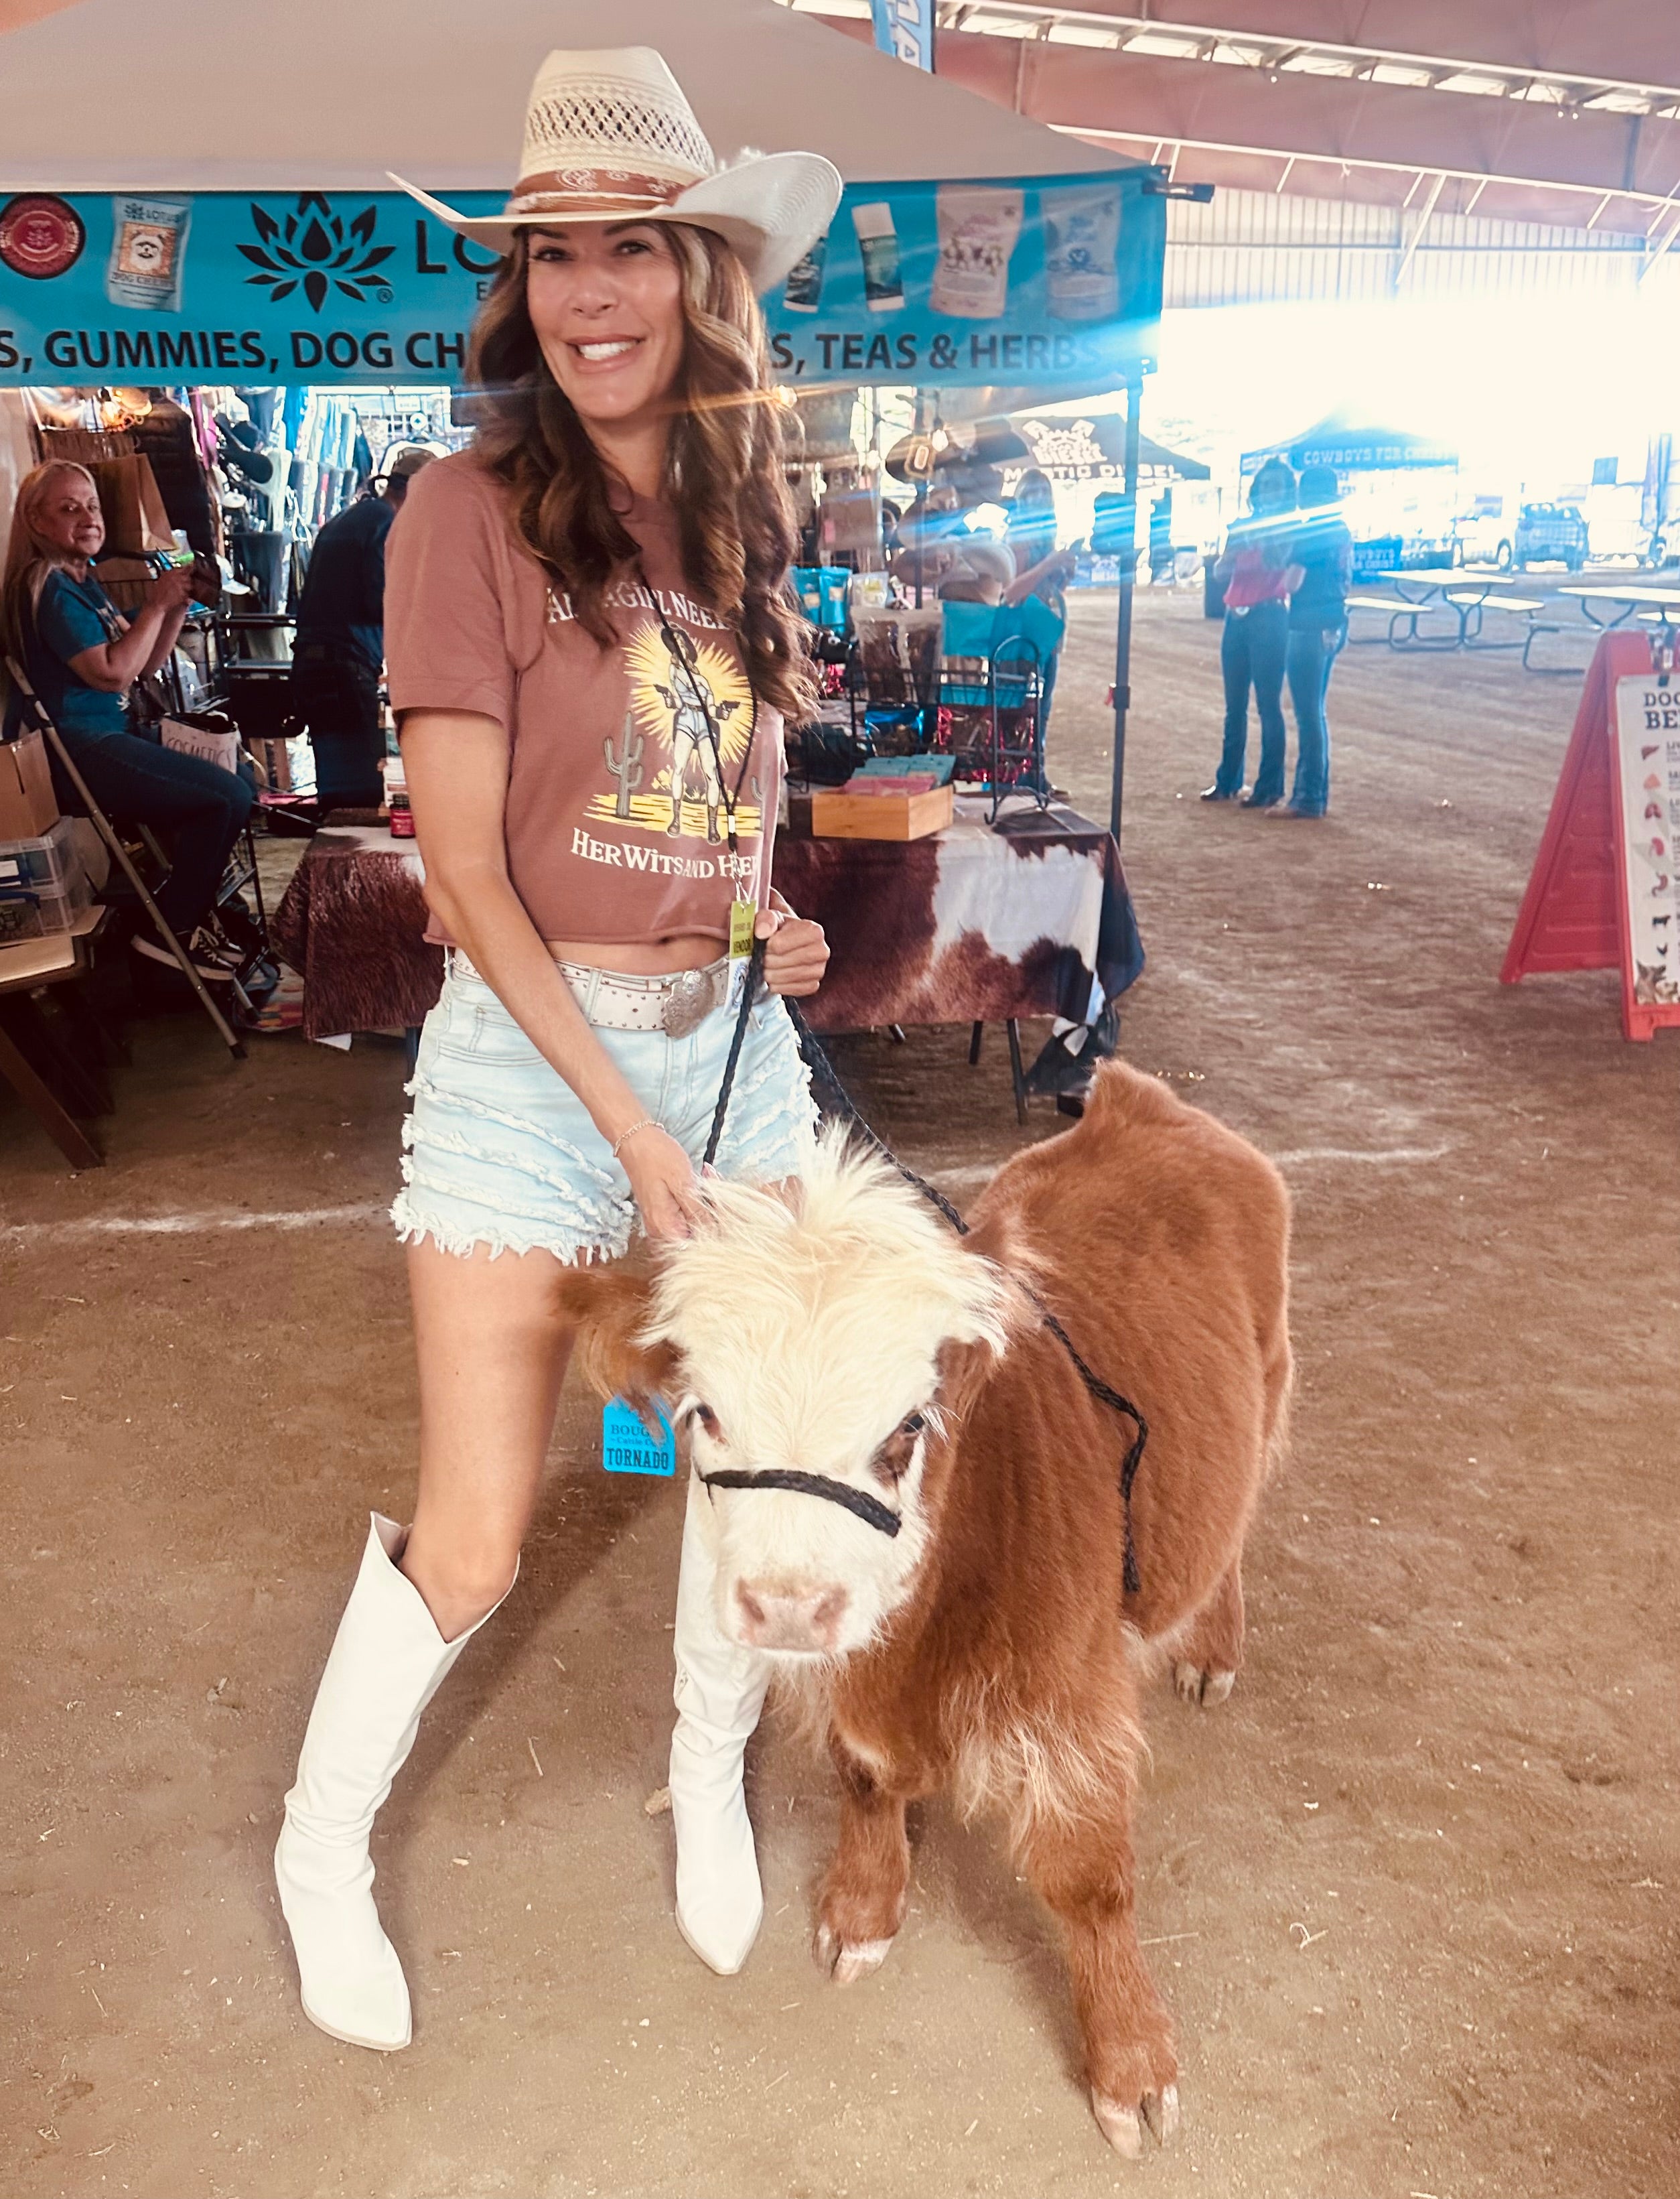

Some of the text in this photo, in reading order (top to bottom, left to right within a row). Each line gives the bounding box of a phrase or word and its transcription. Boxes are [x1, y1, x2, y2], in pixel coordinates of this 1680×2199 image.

[44, 330, 279, 373] GUMMIES,
[290, 331, 393, 369] DOG
[815, 333, 918, 369] TEAS
[929, 333, 958, 369] &
[969, 334, 1101, 369] HERBS
[1099, 463, 1182, 479] DISEL
[1303, 447, 1372, 465] COWBOYS
[571, 827, 623, 867] HER
[606, 1447, 669, 1471] TORNADO
